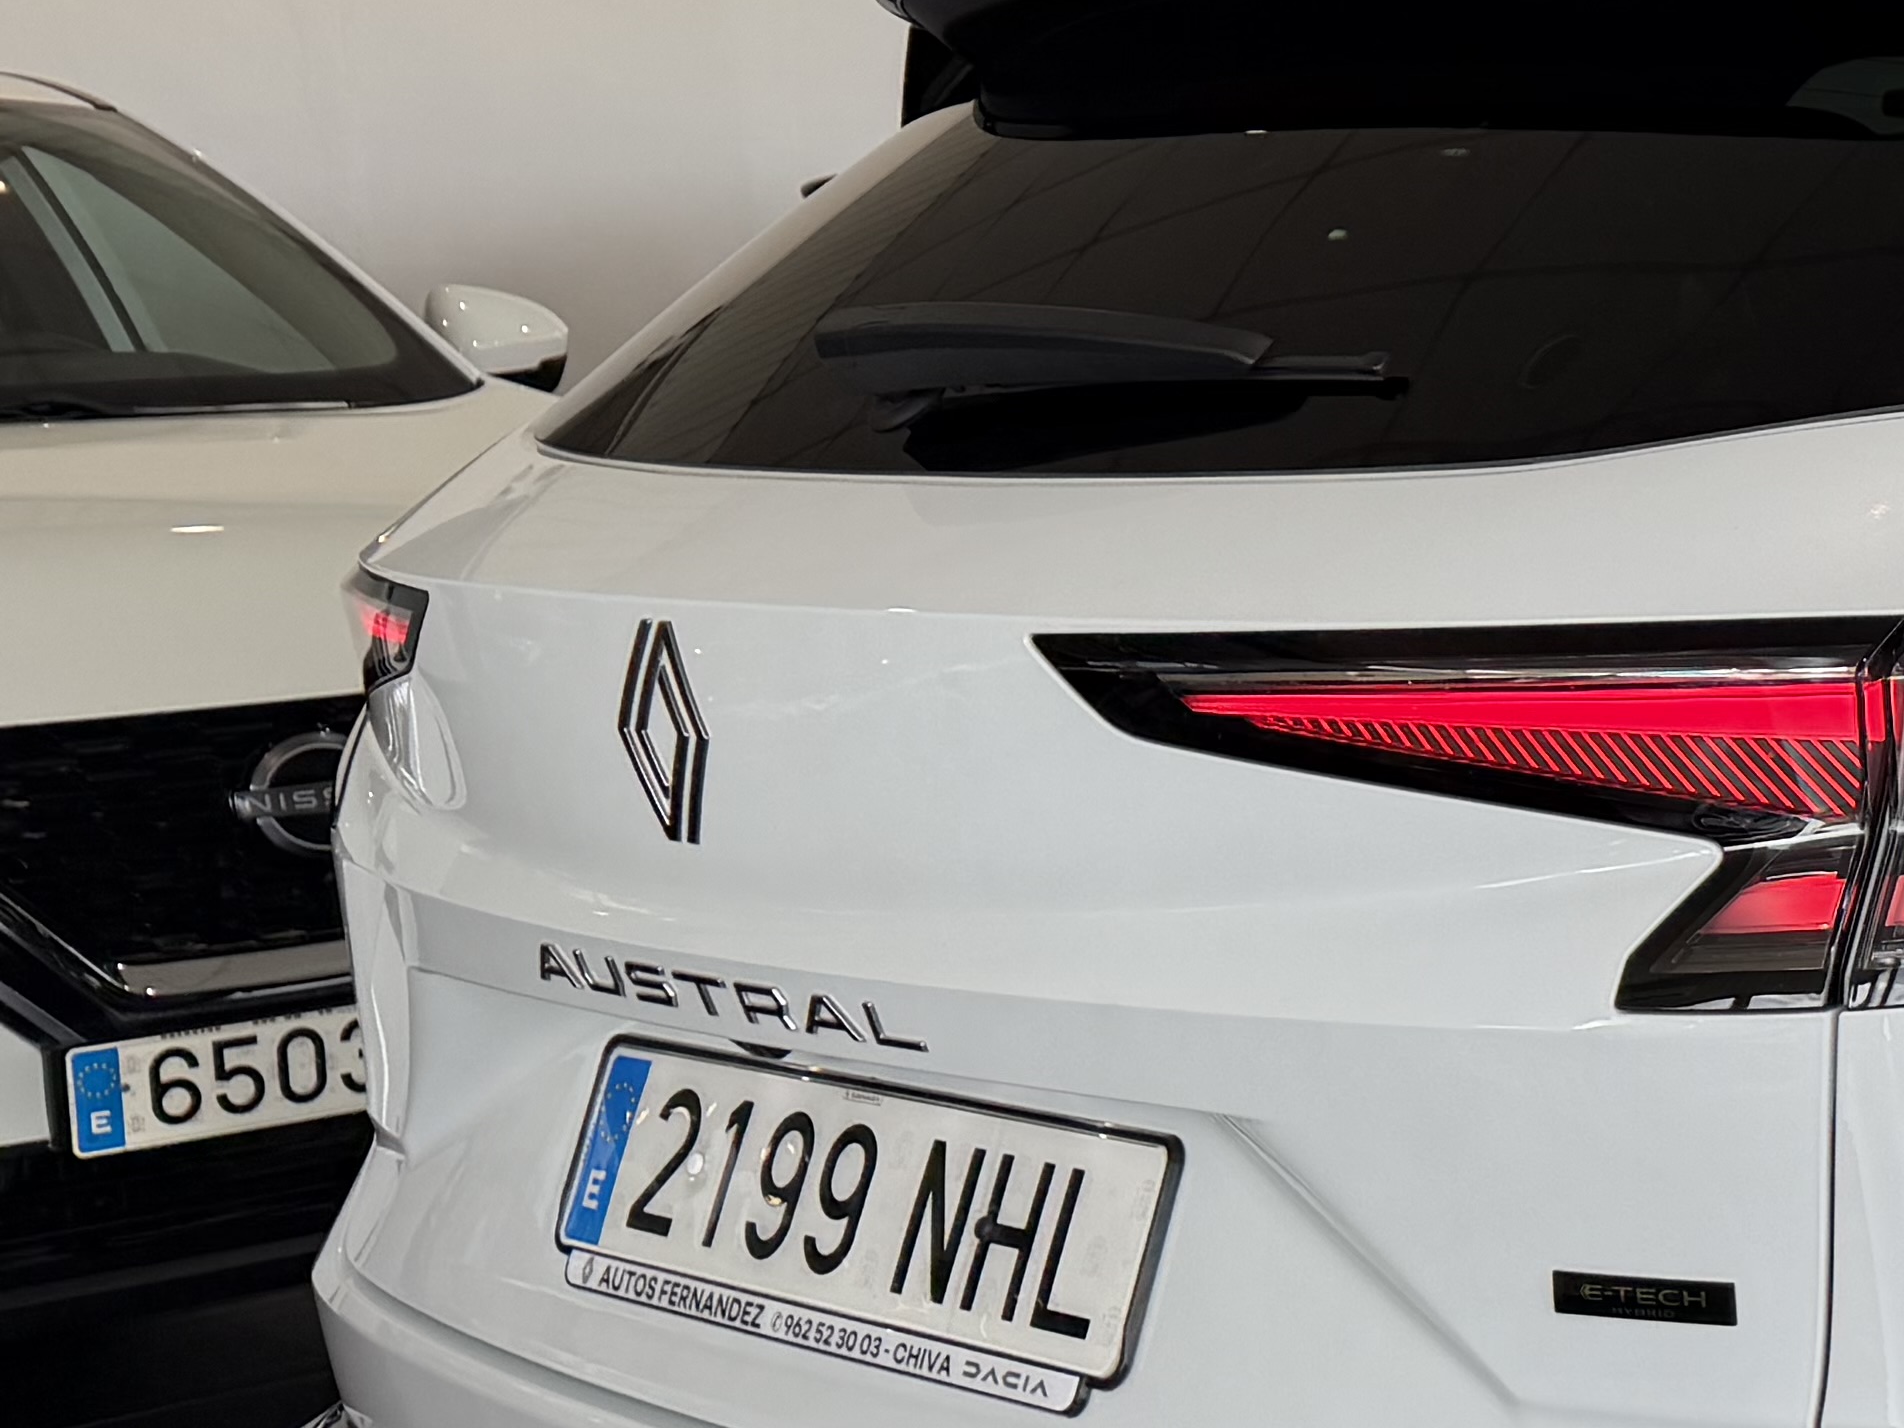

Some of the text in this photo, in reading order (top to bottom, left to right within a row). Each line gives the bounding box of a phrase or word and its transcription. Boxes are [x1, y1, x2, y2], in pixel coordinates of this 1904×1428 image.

[539, 942, 929, 1053] AUSTRAL
[90, 1110, 111, 1134] E
[582, 1168, 607, 1210] E
[625, 1088, 1091, 1340] 2199 NHL
[597, 1264, 657, 1301] AUTOS
[658, 1279, 766, 1329] FERNANDEZ
[783, 1314, 810, 1340] 962
[814, 1322, 833, 1346] 52
[834, 1328, 858, 1352] 30
[859, 1334, 883, 1359] 03
[893, 1342, 951, 1377] CHIVA
[962, 1360, 1050, 1398] DACIA
[1580, 1283, 1706, 1308] E-TECH
